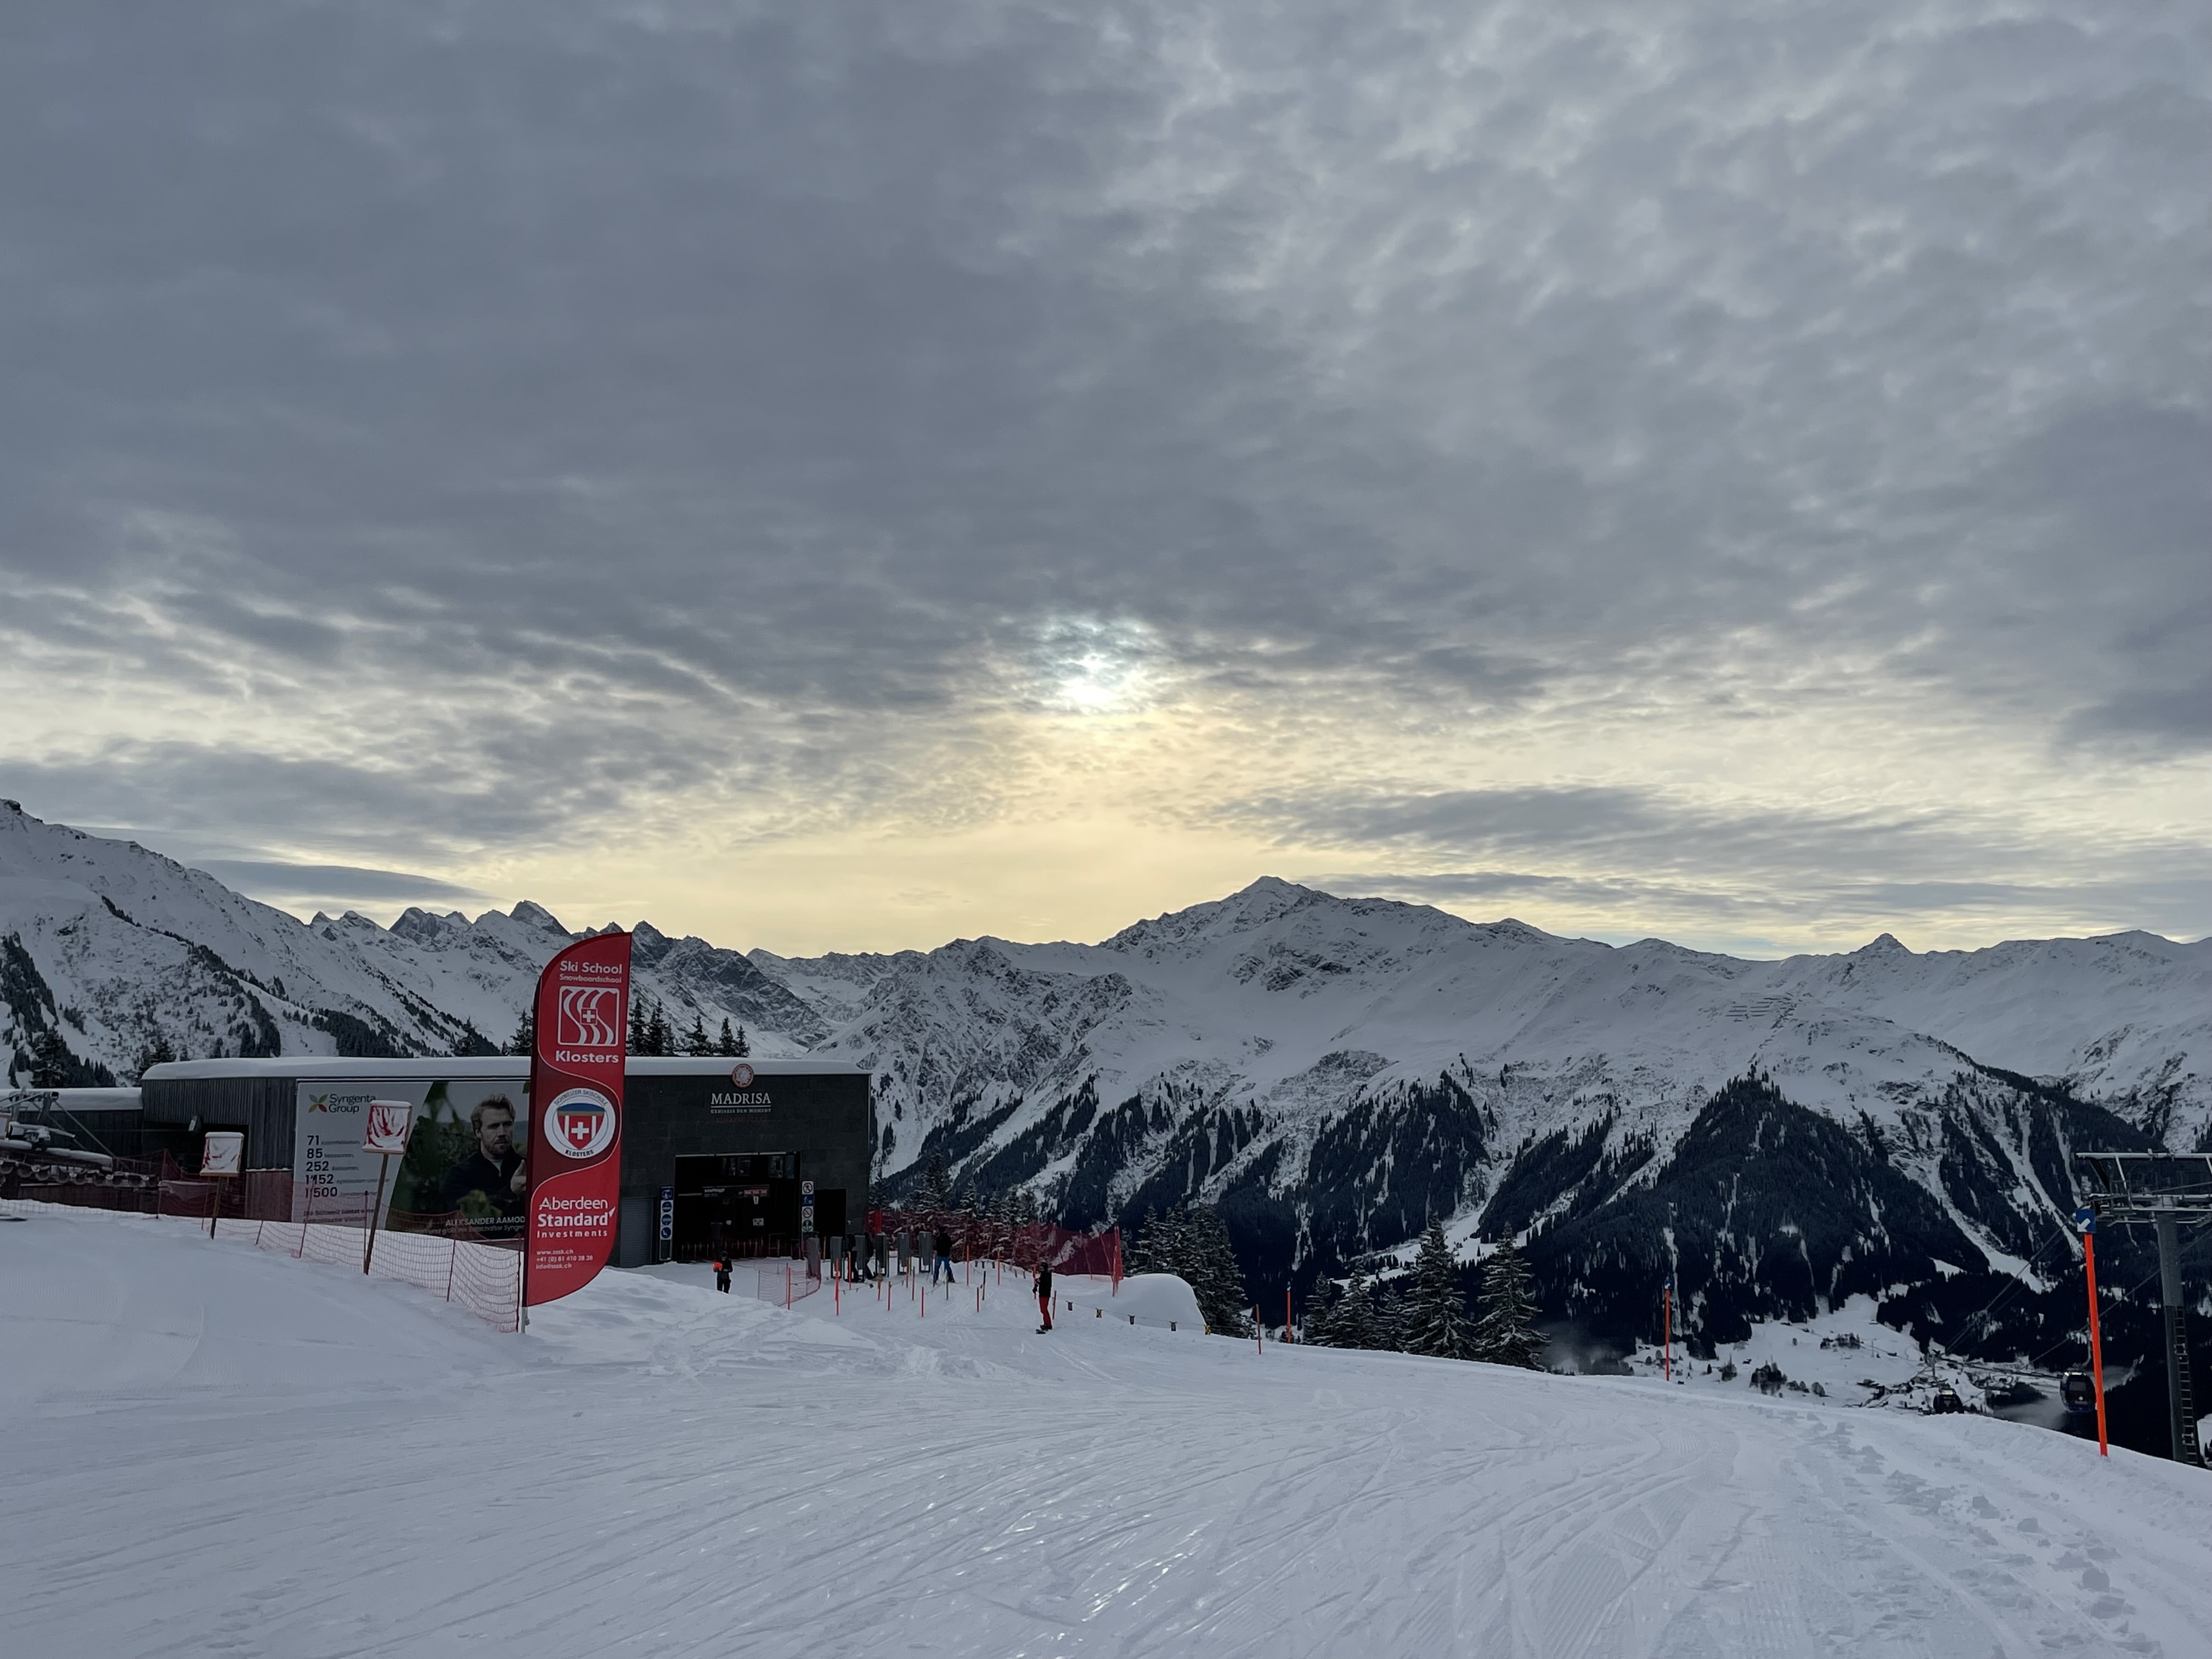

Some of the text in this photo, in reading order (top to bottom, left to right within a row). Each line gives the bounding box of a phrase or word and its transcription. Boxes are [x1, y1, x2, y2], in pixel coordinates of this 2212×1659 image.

[560, 961, 622, 974] Ski School
[559, 974, 622, 983] Snowboardschool
[555, 1050, 619, 1063] Klosters
[329, 1093, 376, 1105] Syngenta
[554, 1090, 608, 1106] SCHWEIZER SKISCHULE
[710, 1092, 771, 1104] MADRISA
[329, 1104, 359, 1114] Group
[307, 1135, 319, 1146] 71
[307, 1148, 323, 1159] 85
[565, 1149, 594, 1158] KLOSTERS
[306, 1161, 329, 1172] 252
[539, 1196, 608, 1210] Aberdeen
[538, 1212, 608, 1227] Standard
[537, 1230, 608, 1238] Investments
